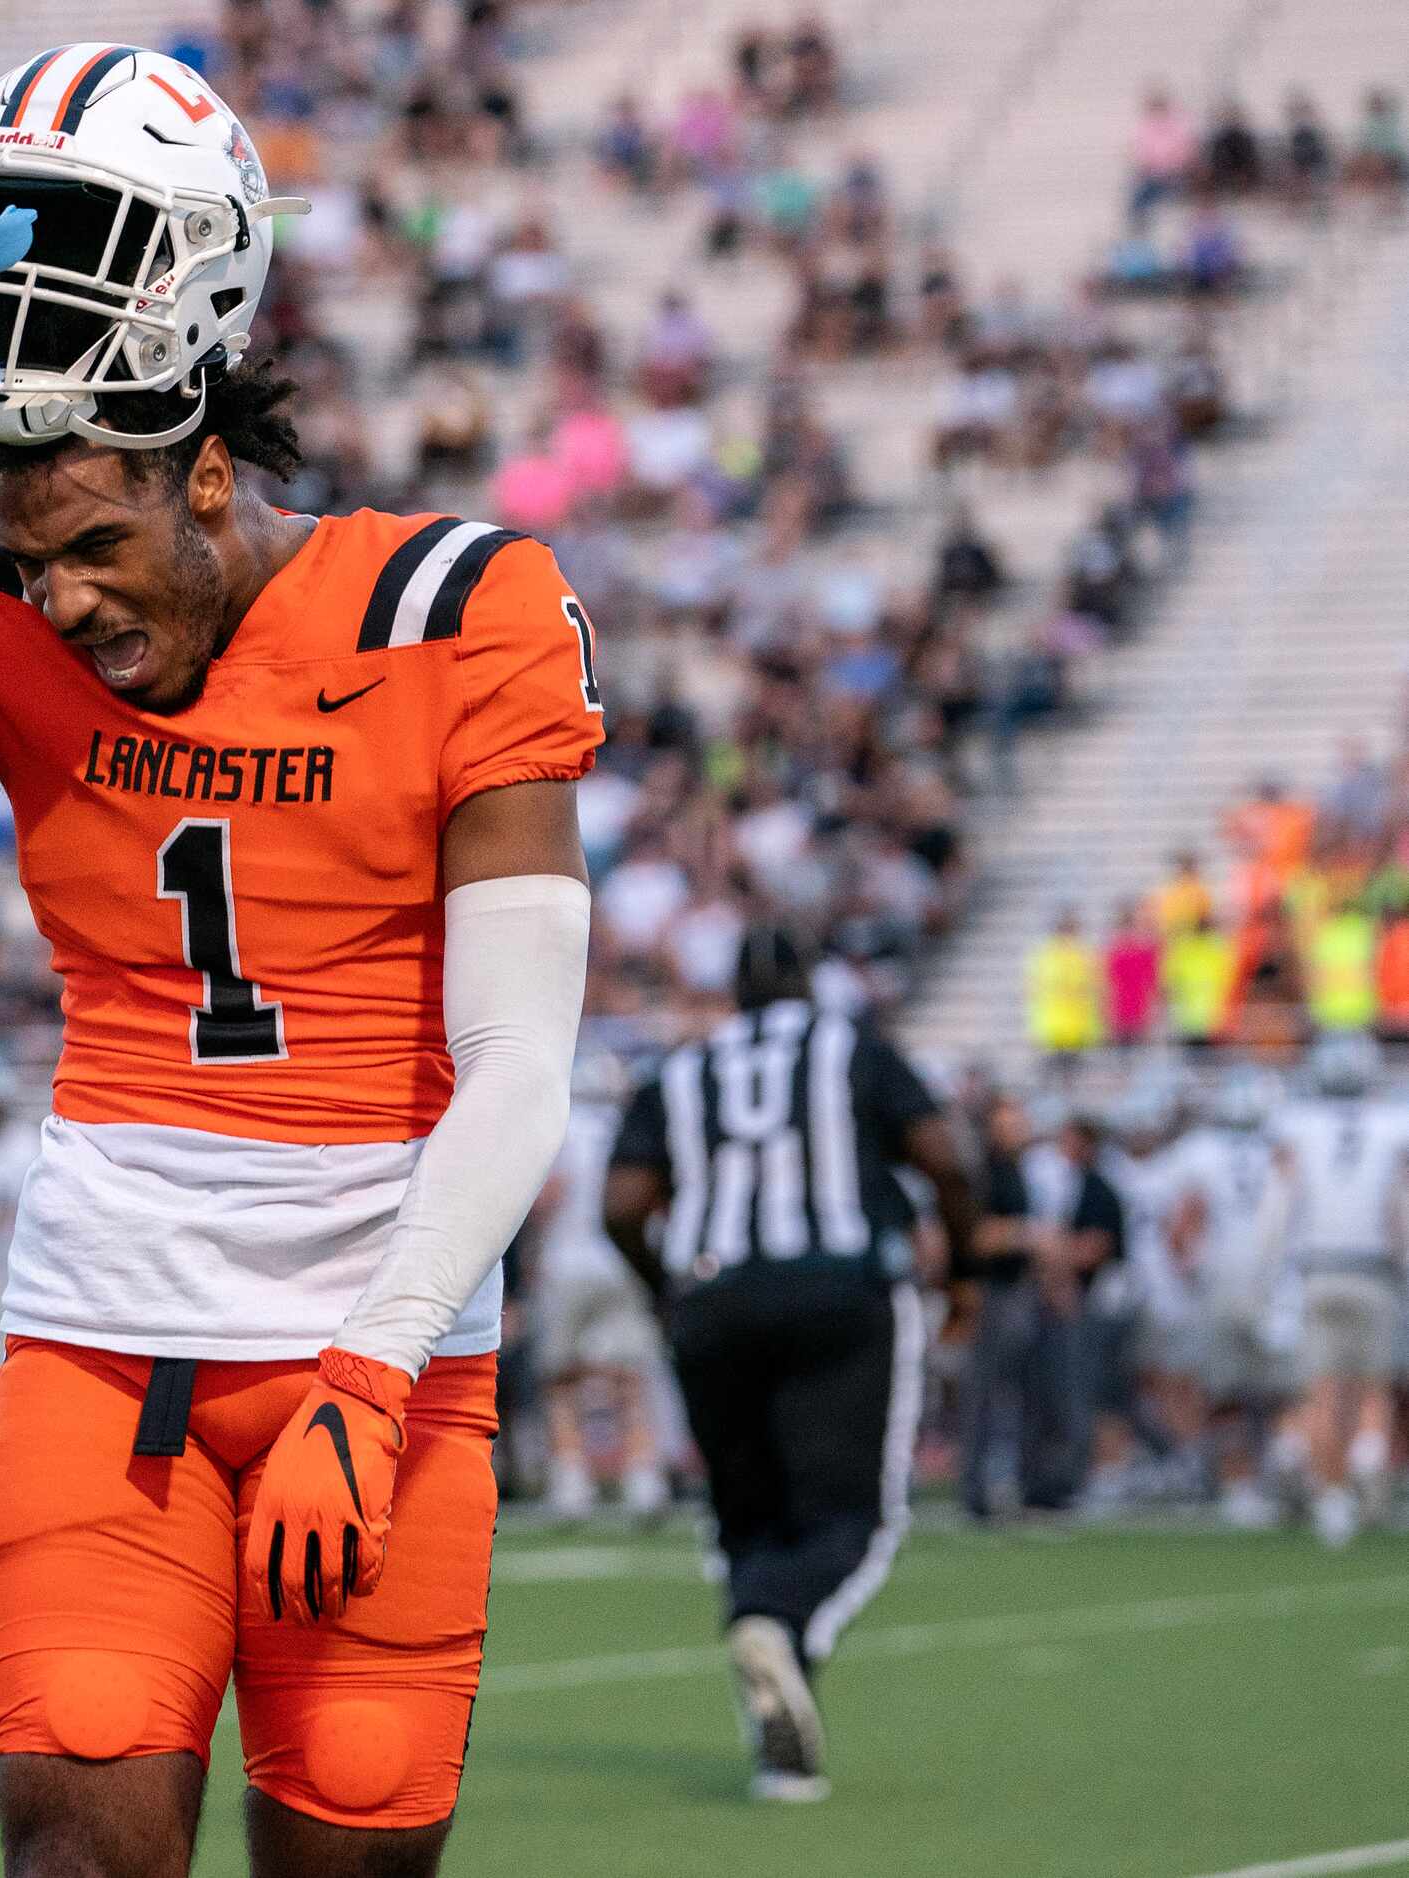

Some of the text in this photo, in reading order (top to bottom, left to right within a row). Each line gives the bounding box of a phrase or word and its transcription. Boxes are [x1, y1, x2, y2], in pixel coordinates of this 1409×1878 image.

[561, 596, 605, 712] 1
[84, 730, 334, 803] LANCASTER
[156, 817, 289, 1065] 1
